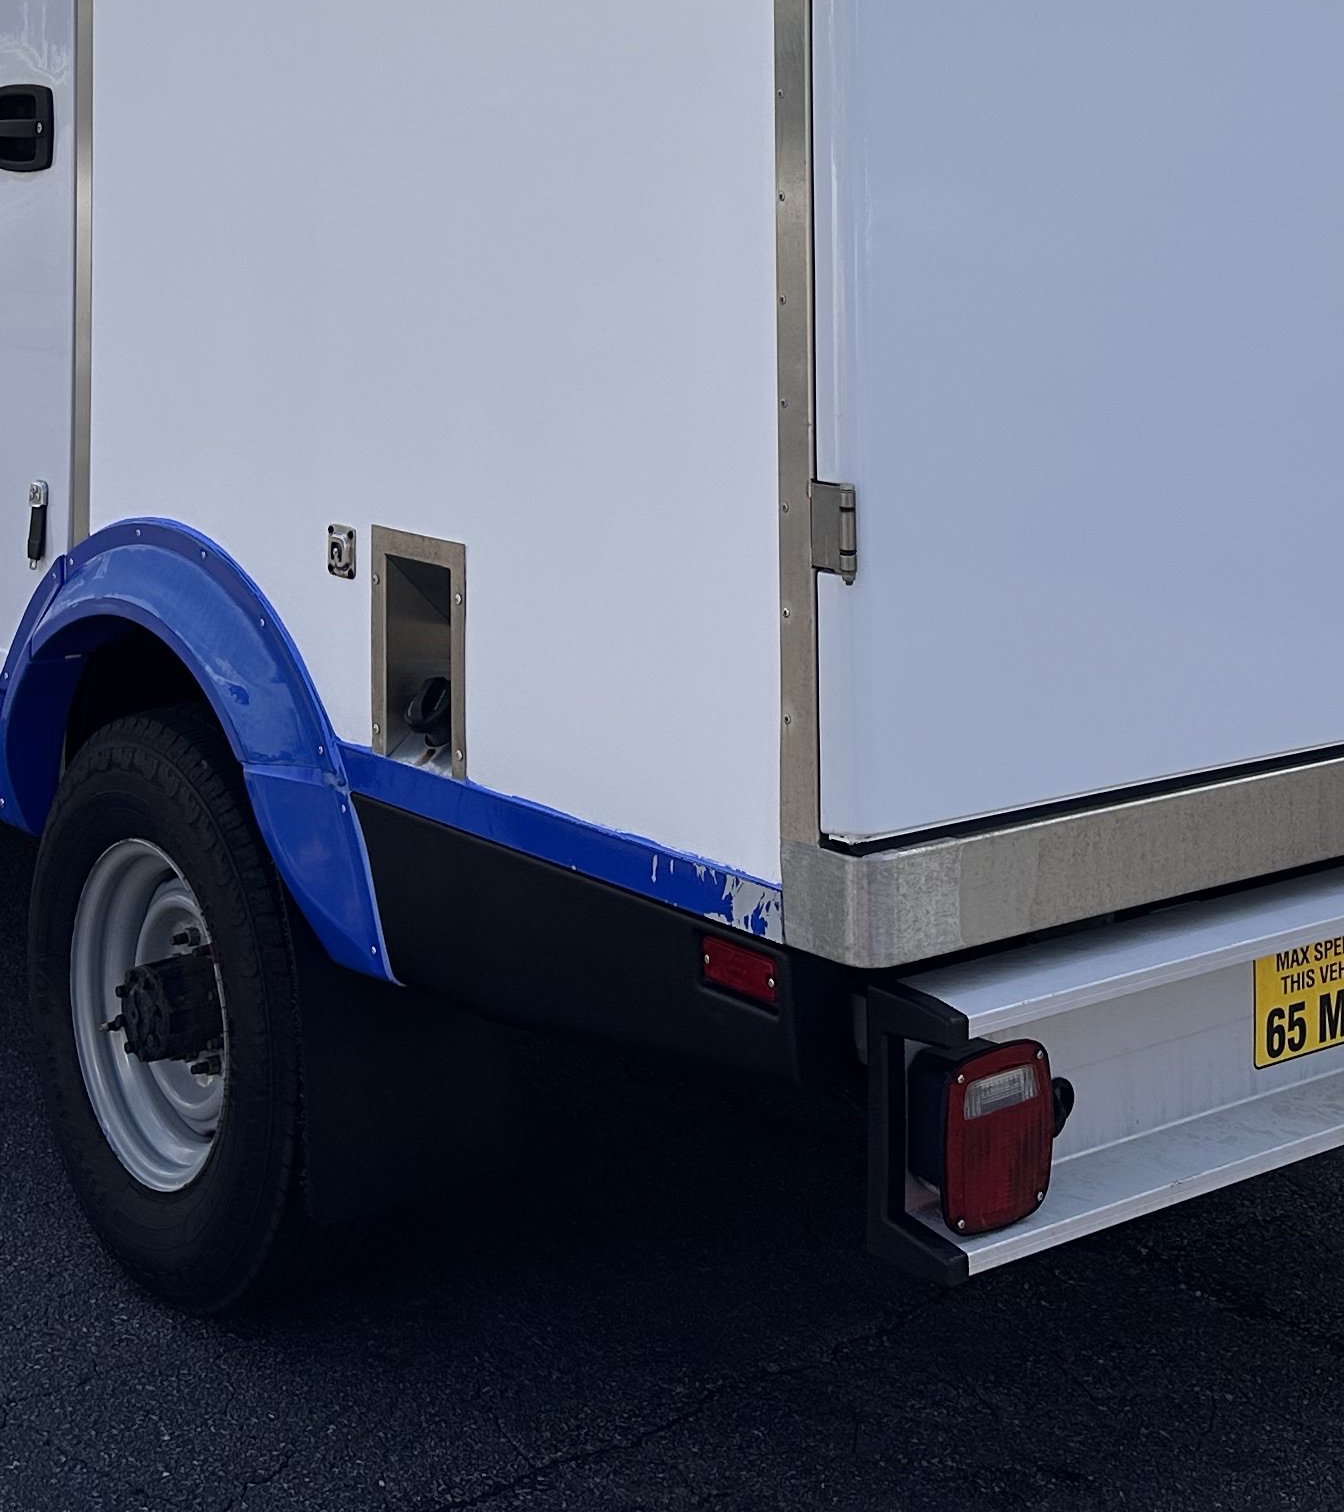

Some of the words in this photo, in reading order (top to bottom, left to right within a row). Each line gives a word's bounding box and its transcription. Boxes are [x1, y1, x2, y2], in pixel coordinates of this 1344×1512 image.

[1276, 945, 1310, 973] MAX
[1281, 968, 1315, 995] THIS
[1266, 1001, 1306, 1059] 65
